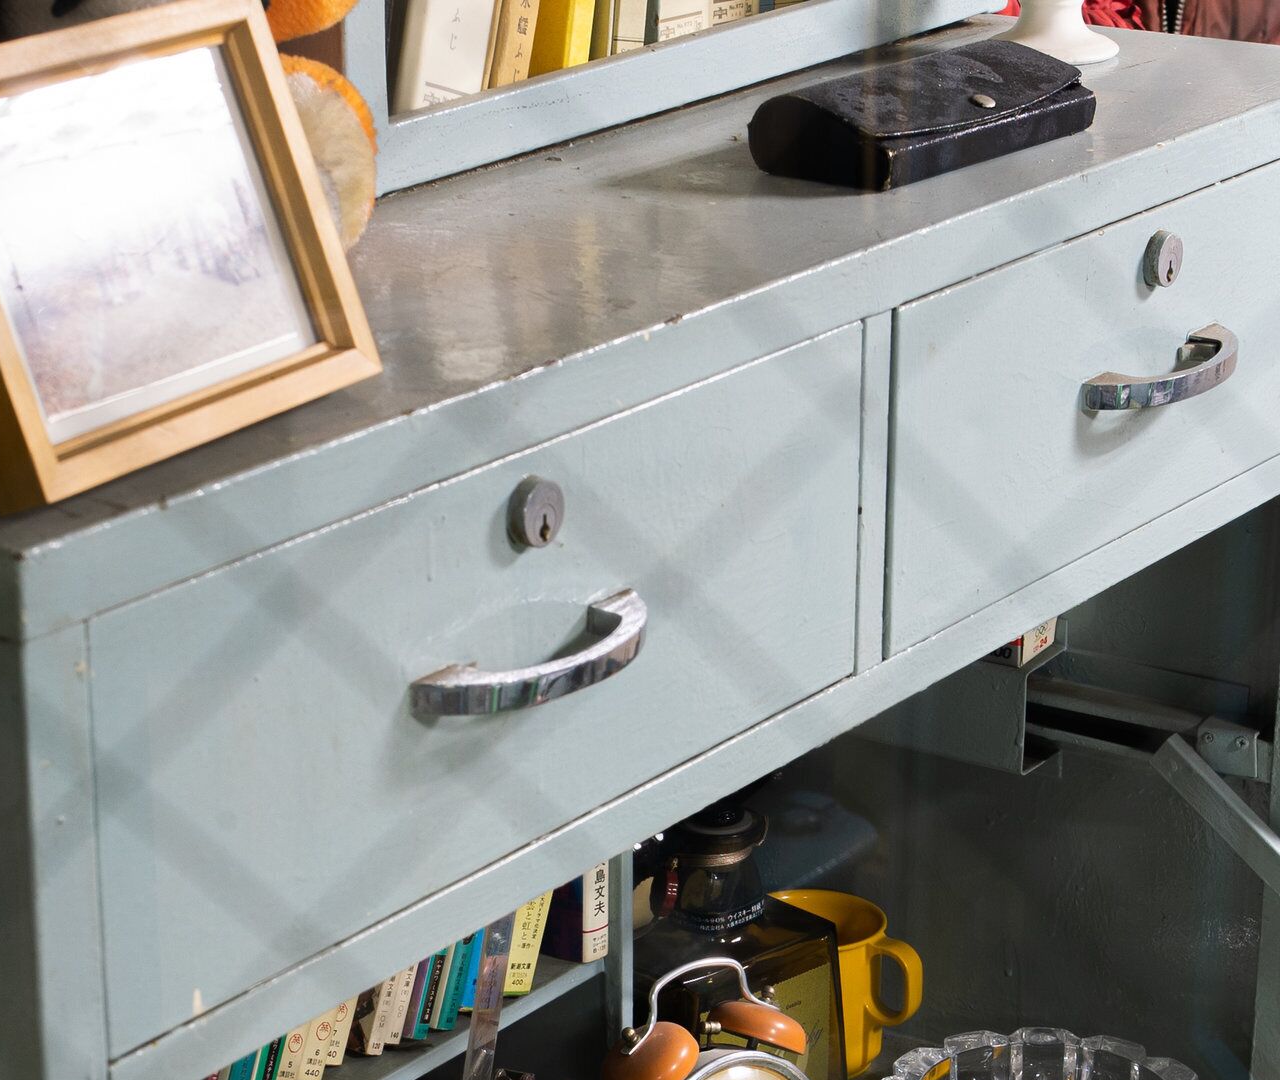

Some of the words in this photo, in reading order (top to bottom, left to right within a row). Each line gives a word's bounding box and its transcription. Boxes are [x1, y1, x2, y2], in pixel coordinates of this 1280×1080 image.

[448, 7, 462, 51] ふじ
[511, 978, 524, 986] 400
[304, 1069, 320, 1077] 440
